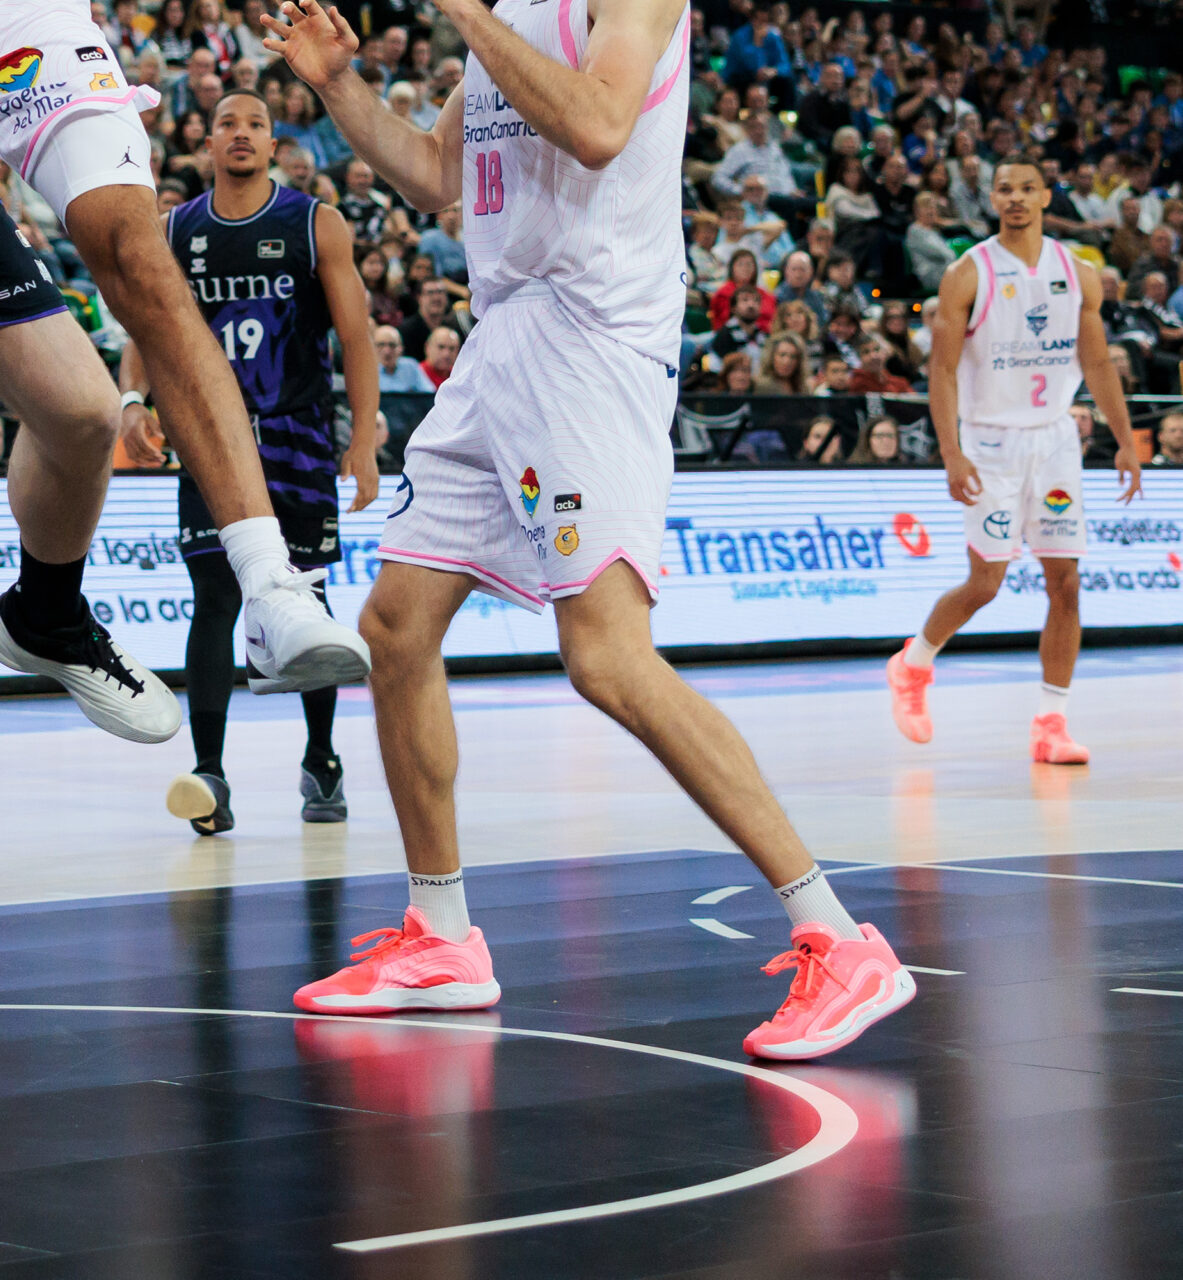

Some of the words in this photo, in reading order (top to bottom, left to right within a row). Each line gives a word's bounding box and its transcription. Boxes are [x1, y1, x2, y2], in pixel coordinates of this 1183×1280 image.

[80, 51, 104, 61] acb
[473, 149, 505, 216] 18
[221, 318, 264, 361] 19
[1031, 373, 1047, 408] 2
[556, 500, 576, 511] acb
[666, 514, 885, 575] Transaher
[118, 595, 151, 623] la
[158, 598, 195, 623] ac
[411, 874, 462, 886] SPALDIN
